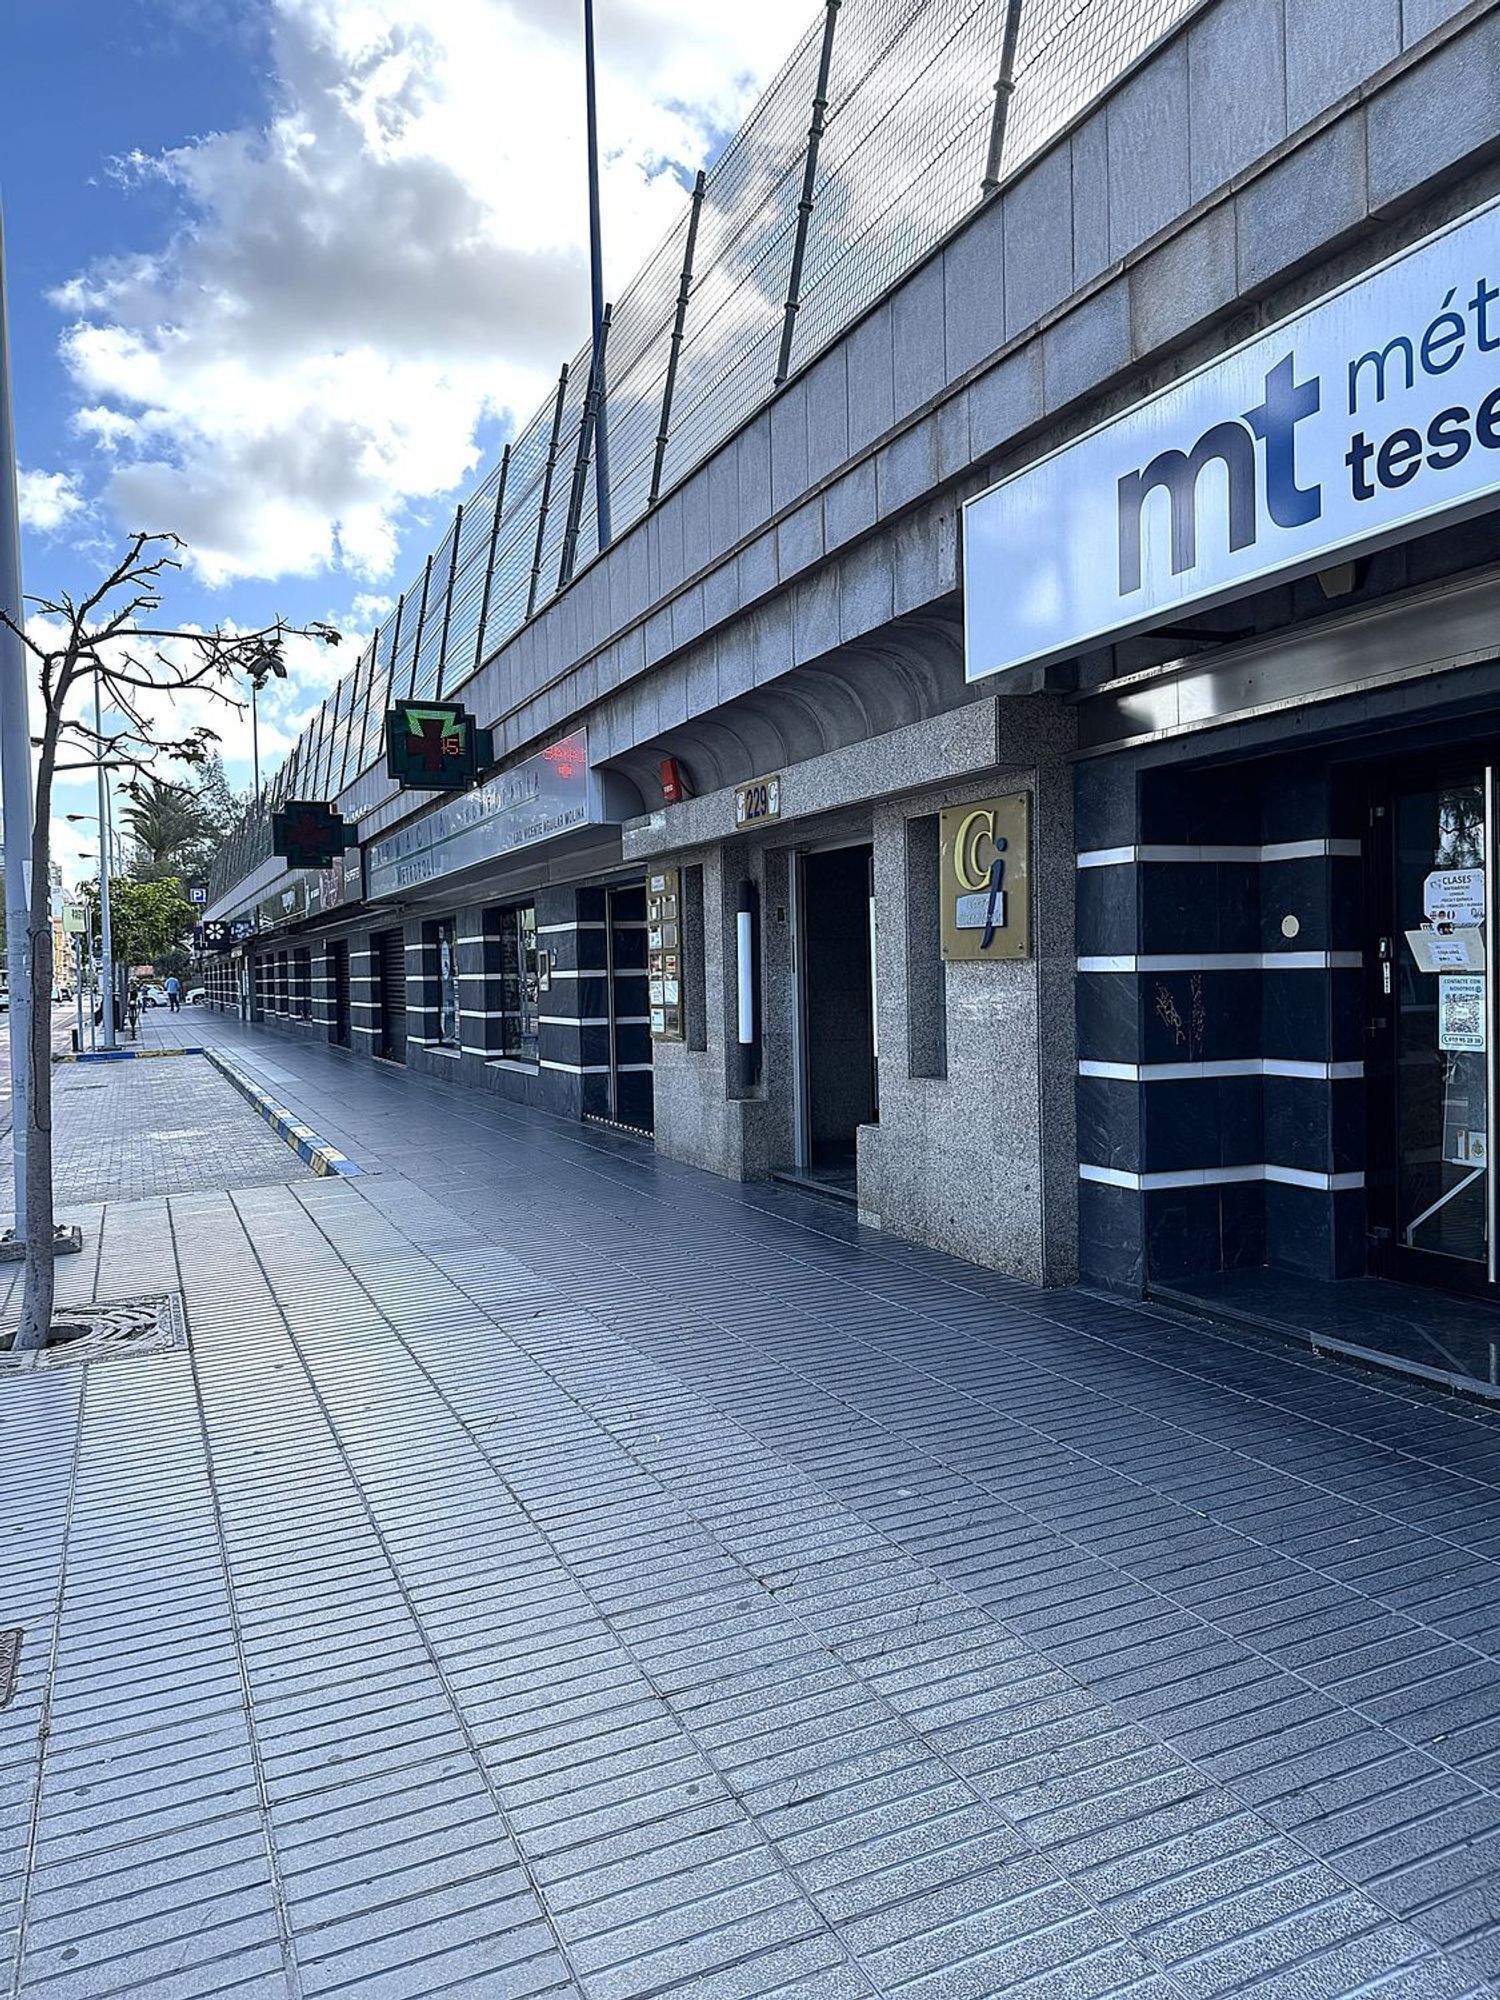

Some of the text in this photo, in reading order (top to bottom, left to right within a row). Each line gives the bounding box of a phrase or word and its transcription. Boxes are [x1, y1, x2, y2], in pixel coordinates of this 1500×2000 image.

[1118, 350, 1321, 597] mt
[747, 785, 766, 819] 229
[1442, 875, 1472, 886] CLASES
[194, 890, 202, 900] P
